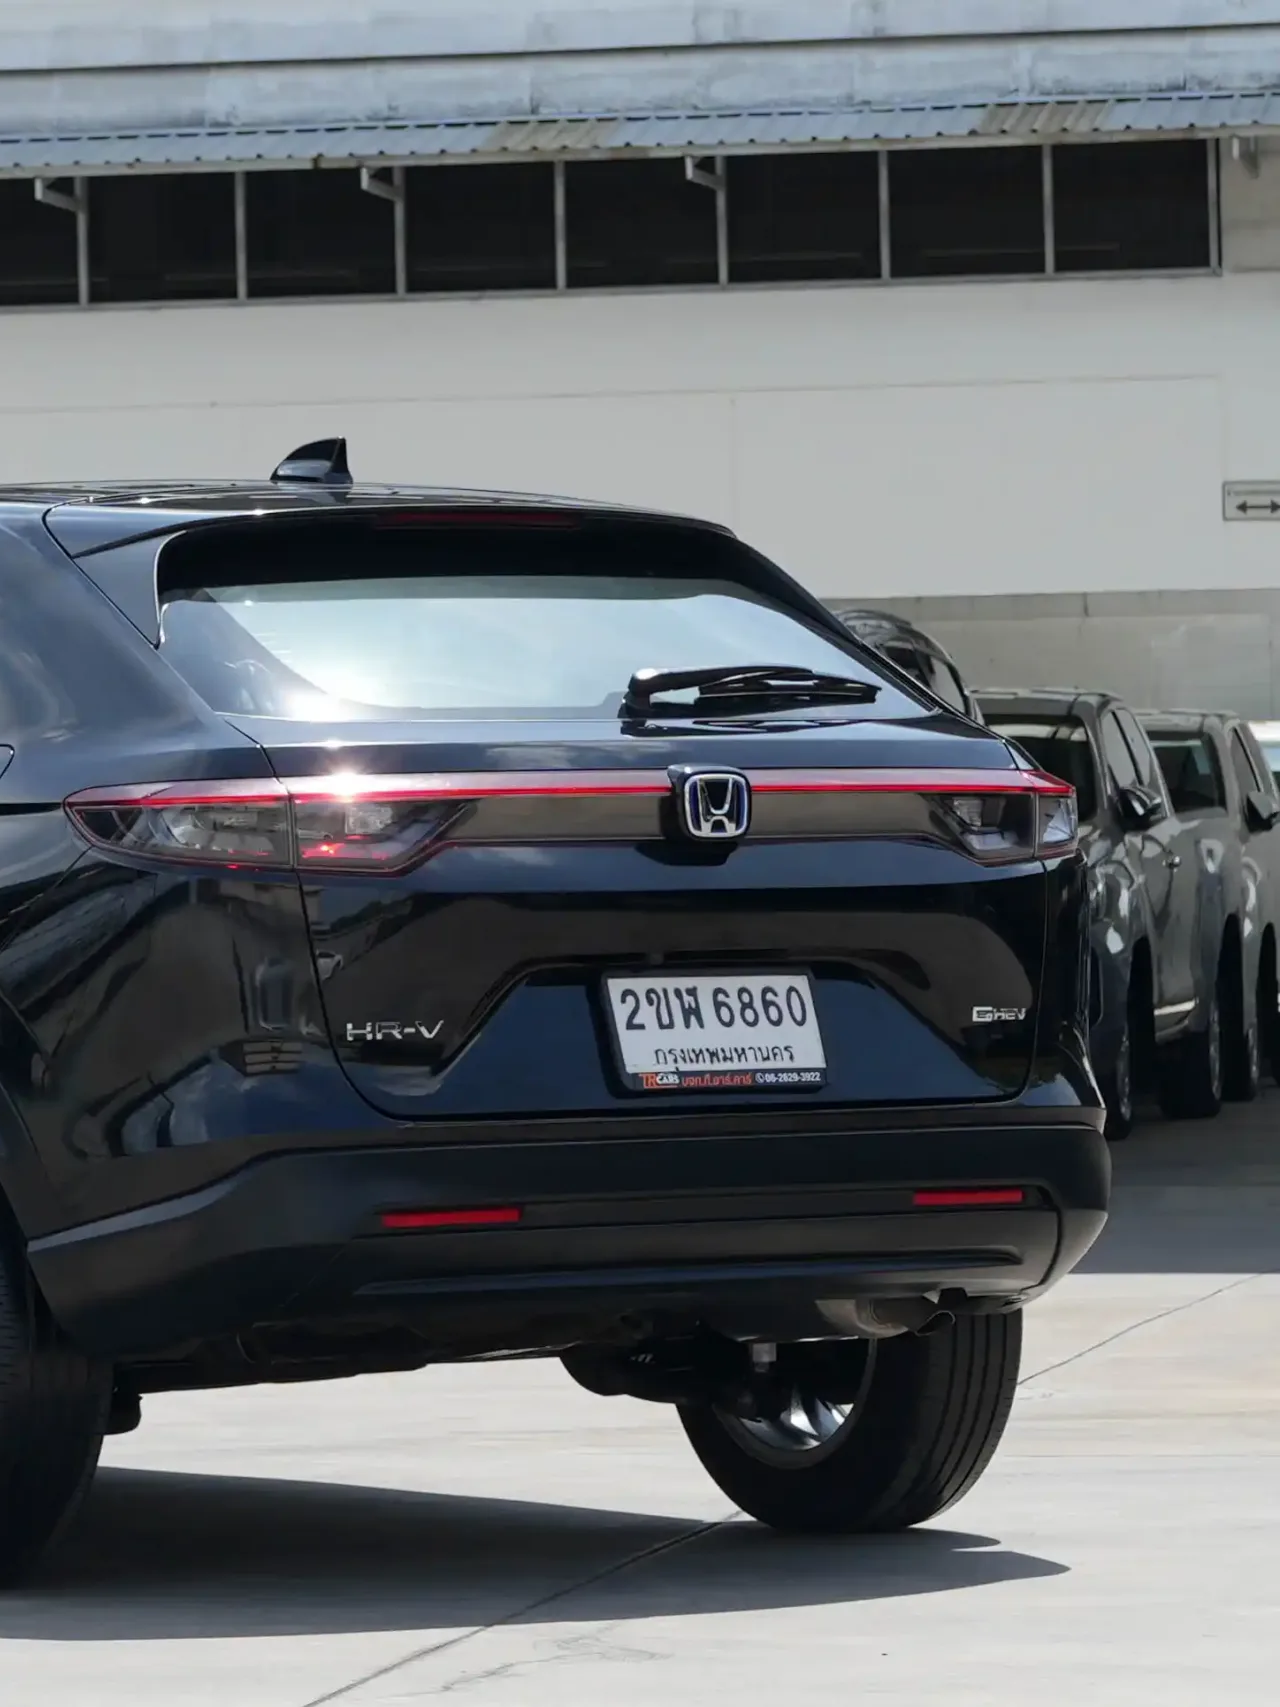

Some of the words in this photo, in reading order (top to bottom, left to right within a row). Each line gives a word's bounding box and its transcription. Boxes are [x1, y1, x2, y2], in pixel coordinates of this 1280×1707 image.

[712, 985, 807, 1028] 6860
[346, 1020, 445, 1041] HR-V
[654, 1045, 795, 1071] กรุงเทพมหานคร
